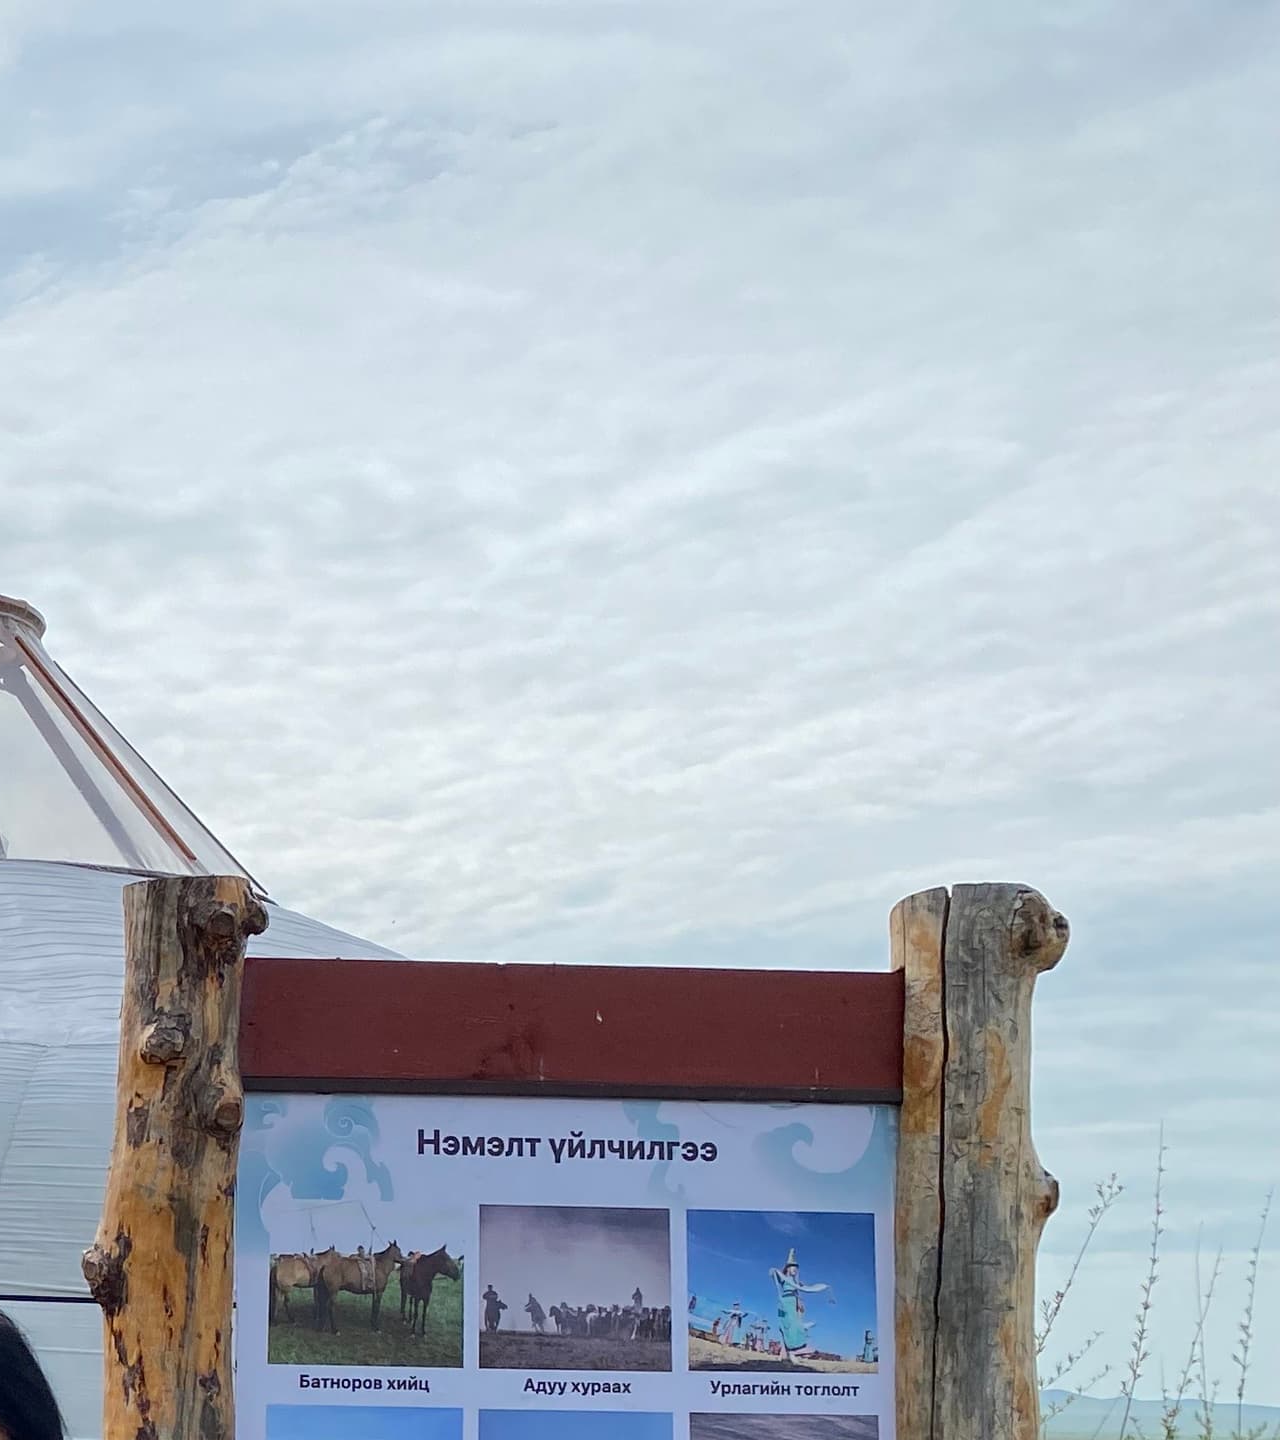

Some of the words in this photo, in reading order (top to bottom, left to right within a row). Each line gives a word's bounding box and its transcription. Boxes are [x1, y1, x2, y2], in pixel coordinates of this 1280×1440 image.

[418, 1129, 542, 1157] Нэмэлт
[548, 1130, 718, 1164] үйлчилгээ
[299, 1374, 383, 1392] Батноров
[387, 1376, 430, 1393] хийц
[523, 1378, 567, 1396] Адуу
[571, 1381, 631, 1396] хураах
[710, 1380, 791, 1398] Урлагийн
[794, 1385, 860, 1397] тоглолт
